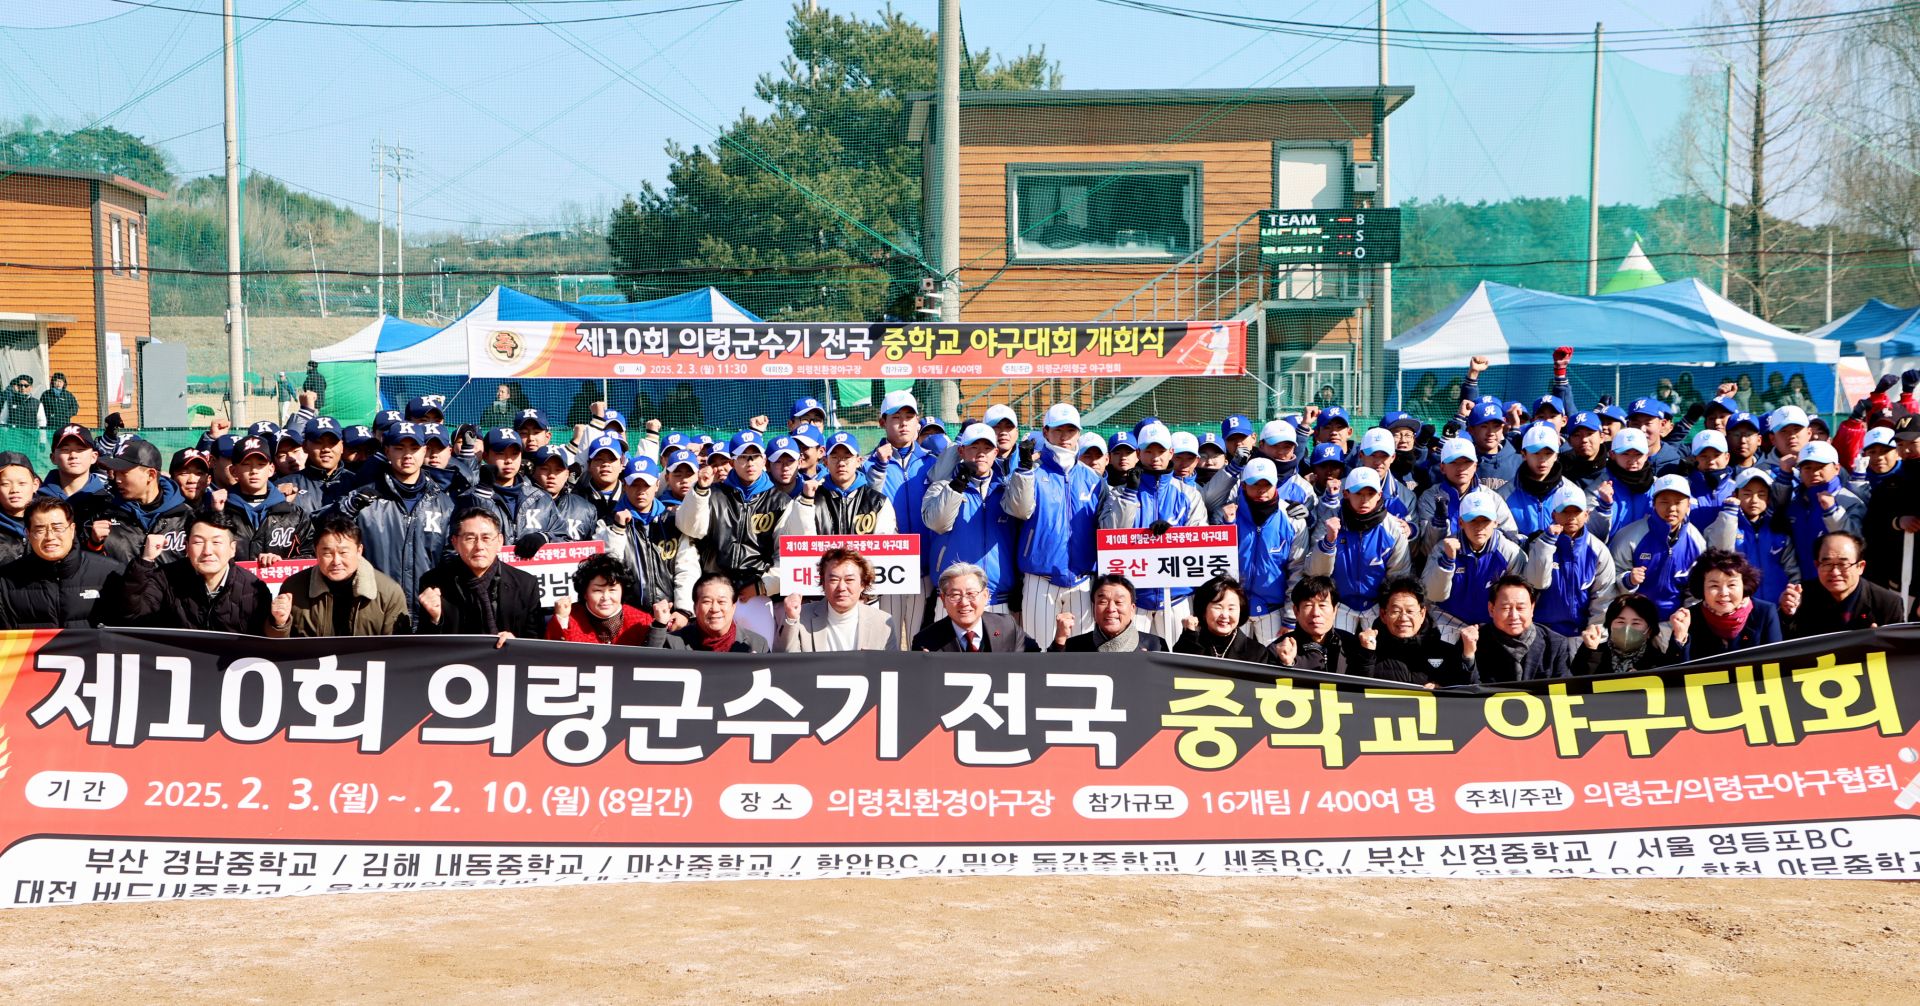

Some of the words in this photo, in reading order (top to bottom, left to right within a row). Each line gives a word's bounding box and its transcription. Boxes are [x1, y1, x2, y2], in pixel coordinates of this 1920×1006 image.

[1269, 214, 1317, 226] TEAM
[1356, 214, 1365, 225] B
[1356, 230, 1364, 242] S
[1355, 247, 1365, 259] O
[576, 327, 669, 357] 제10회
[679, 327, 810, 360] 의령군수기
[820, 328, 873, 359] 전국
[881, 326, 962, 360] 중학교
[970, 326, 1077, 357] 야구대회
[1086, 326, 1165, 358] 개회식
[718, 364, 748, 374] 11:30
[918, 364, 943, 375] 16개팀
[387, 410, 402, 421] K
[524, 409, 538, 418] K
[257, 421, 272, 433] K
[317, 417, 333, 428] K
[400, 422, 415, 434] K
[425, 422, 440, 434] K
[1229, 417, 1239, 428] B
[1895, 417, 1912, 429] N
[356, 426, 371, 437] K
[500, 428, 516, 439] K
[1118, 432, 1127, 440] B
[1205, 433, 1214, 441] B
[424, 511, 441, 532] K
[526, 509, 540, 528] K
[568, 519, 582, 540] K
[1106, 534, 1128, 545] 제10회
[1165, 532, 1199, 544] 전국중학교
[1201, 531, 1229, 542] 야구대회
[786, 541, 808, 551] 제10회
[883, 539, 909, 550] 야구대회
[1107, 558, 1148, 577] 울산
[1157, 554, 1230, 578] 제일중
[30, 653, 386, 752] 제10회
[421, 662, 898, 765] 의령군수기
[940, 671, 1127, 767] 전국
[1161, 676, 1455, 769] 중학교
[1484, 651, 1904, 757] 야구대회
[1583, 763, 1899, 808] 의령군/의령군야구협회
[145, 780, 228, 810] 2025.
[329, 782, 379, 814] (월)
[483, 781, 532, 813] 10.
[542, 786, 590, 817] (월)
[598, 786, 693, 818] (8일간)
[827, 788, 1055, 818] 의령친환경야구장
[1089, 791, 1175, 813] 참가규모
[1203, 788, 1290, 816] 16개팀
[1317, 788, 1400, 814] 400여
[1408, 786, 1436, 813] 명
[1466, 786, 1563, 808] 주최/주관
[85, 848, 148, 875] 부산
[163, 849, 317, 877] 경남중학교
[363, 852, 420, 877] 김해
[435, 853, 583, 876] 내동중학교
[1367, 846, 1425, 867] 부산
[1440, 841, 1592, 867] 신정중학교
[1637, 836, 1695, 859] 서울
[1708, 828, 1853, 856] 영등포BC
